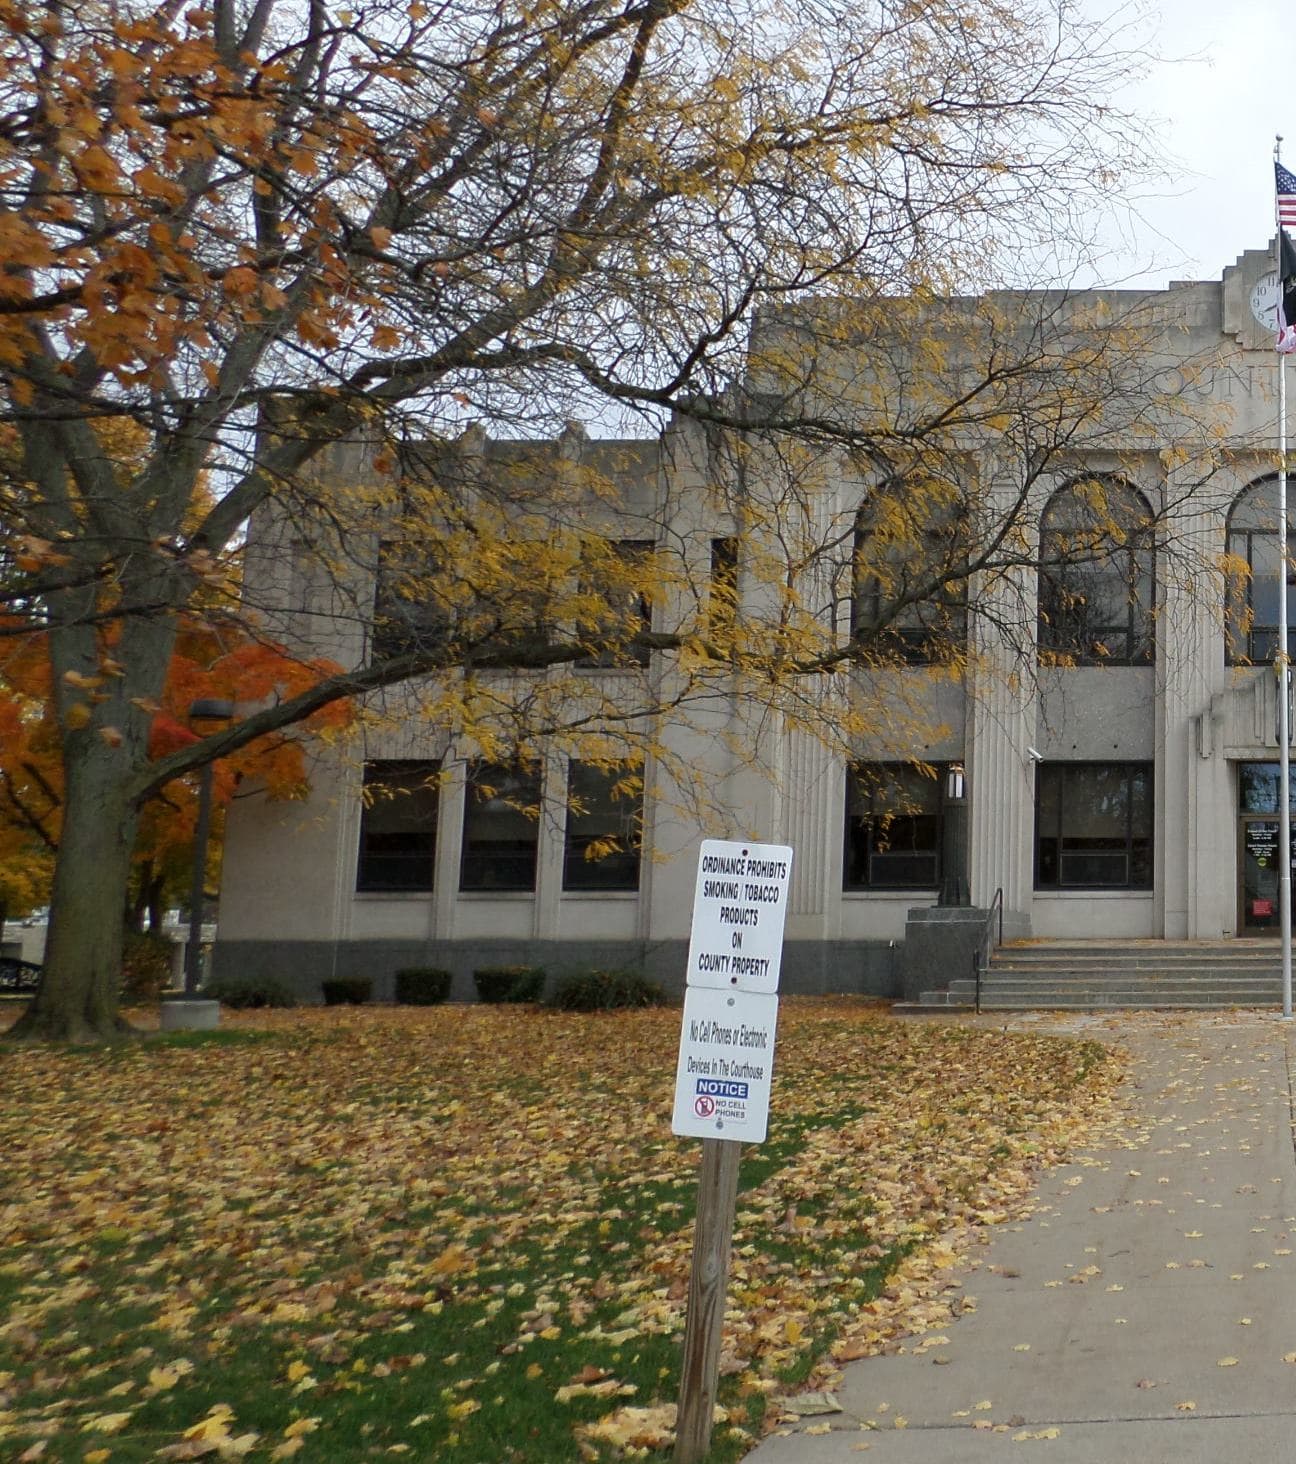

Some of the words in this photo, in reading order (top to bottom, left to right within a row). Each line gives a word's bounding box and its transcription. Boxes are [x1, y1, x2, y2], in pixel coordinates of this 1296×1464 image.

[1257, 287, 1267, 296] 10
[1253, 299, 1259, 307] 9
[702, 856, 745, 875] ORDINANCE
[746, 860, 786, 879] PROHIBITS
[704, 881, 738, 899] SMOKING
[745, 884, 779, 903] TOBACCO
[720, 907, 758, 926] PRODUCTS
[732, 931, 742, 949] ON
[699, 953, 730, 972] COUNTY
[732, 957, 769, 976] PROPERTY
[690, 1020, 698, 1042] No
[699, 1020, 712, 1044] Cell
[711, 1021, 732, 1045] Phones
[732, 1029, 739, 1046] or
[740, 1024, 767, 1048] Electronic
[687, 1056, 710, 1074] Devices
[712, 1058, 717, 1075] In
[720, 1059, 729, 1076] The
[730, 1060, 763, 1080] Courthouse
[698, 1081, 746, 1096] NOTICE
[715, 1109, 745, 1119] PHONES
[728, 1101, 746, 1110] CELL
